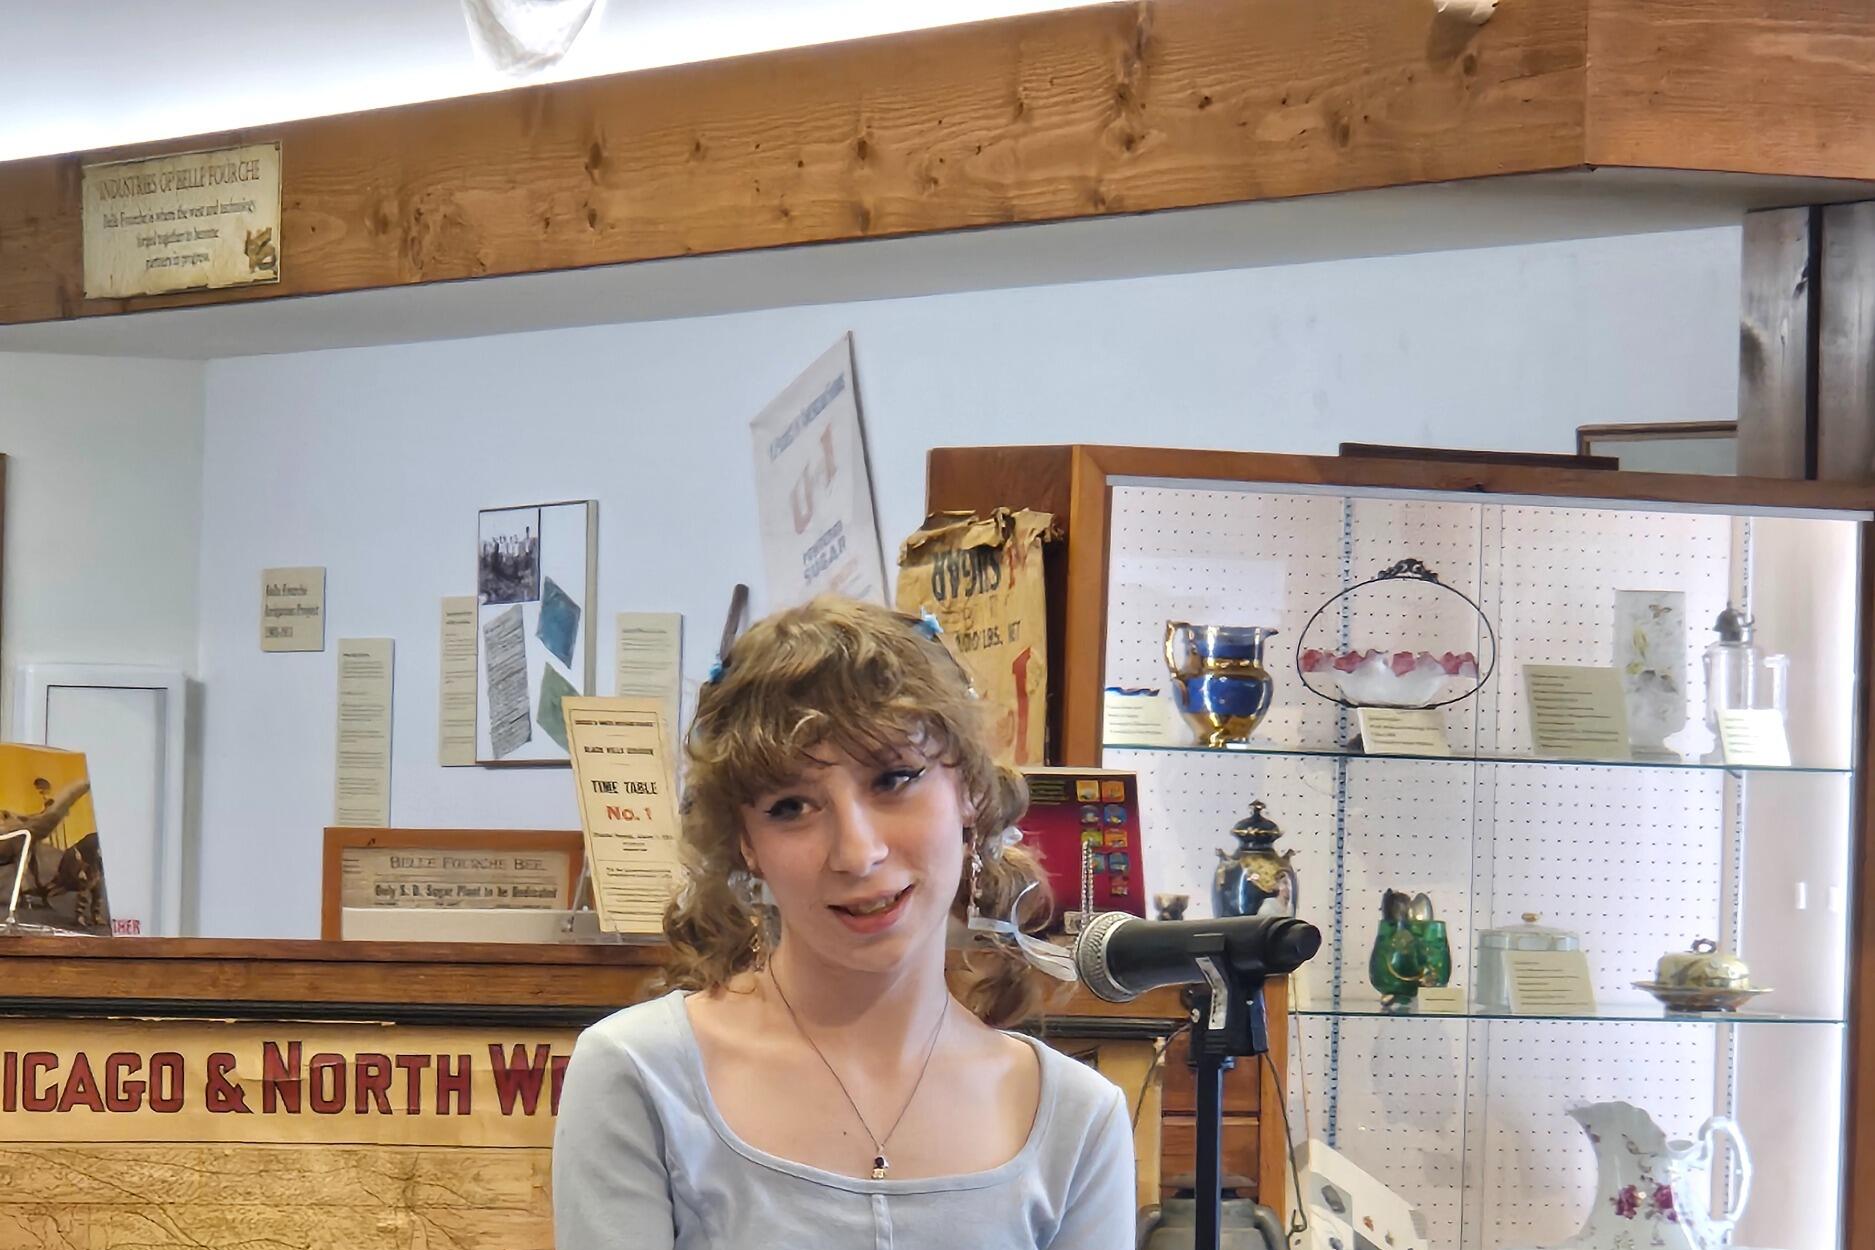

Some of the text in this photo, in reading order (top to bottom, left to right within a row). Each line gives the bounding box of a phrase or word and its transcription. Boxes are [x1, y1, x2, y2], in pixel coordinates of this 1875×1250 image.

[98, 159, 260, 201] INDUSTRIES OF BELLE FOURCHE
[804, 535, 847, 586] SUGAR
[931, 549, 1000, 601] SUGAR
[591, 780, 658, 795] TIME TABLE
[3, 1051, 185, 1113] ICAGO
[206, 1055, 253, 1114] &
[262, 1040, 472, 1116] NORTH
